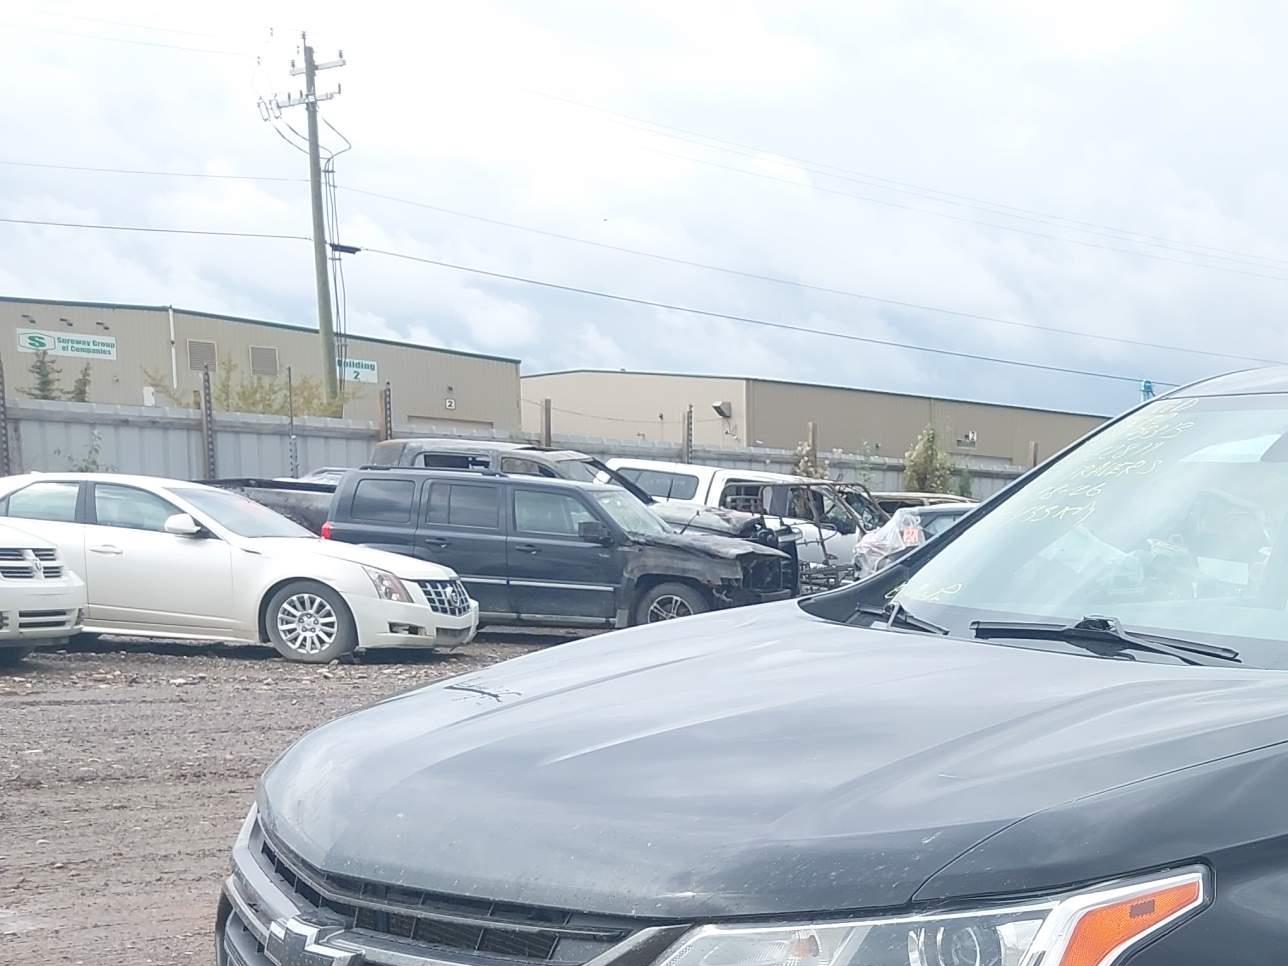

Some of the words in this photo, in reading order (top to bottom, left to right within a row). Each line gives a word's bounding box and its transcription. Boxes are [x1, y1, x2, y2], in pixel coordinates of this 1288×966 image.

[92, 340, 115, 349] Group
[70, 346, 112, 355] Companies
[353, 370, 361, 380] 2
[447, 400, 454, 408] 2
